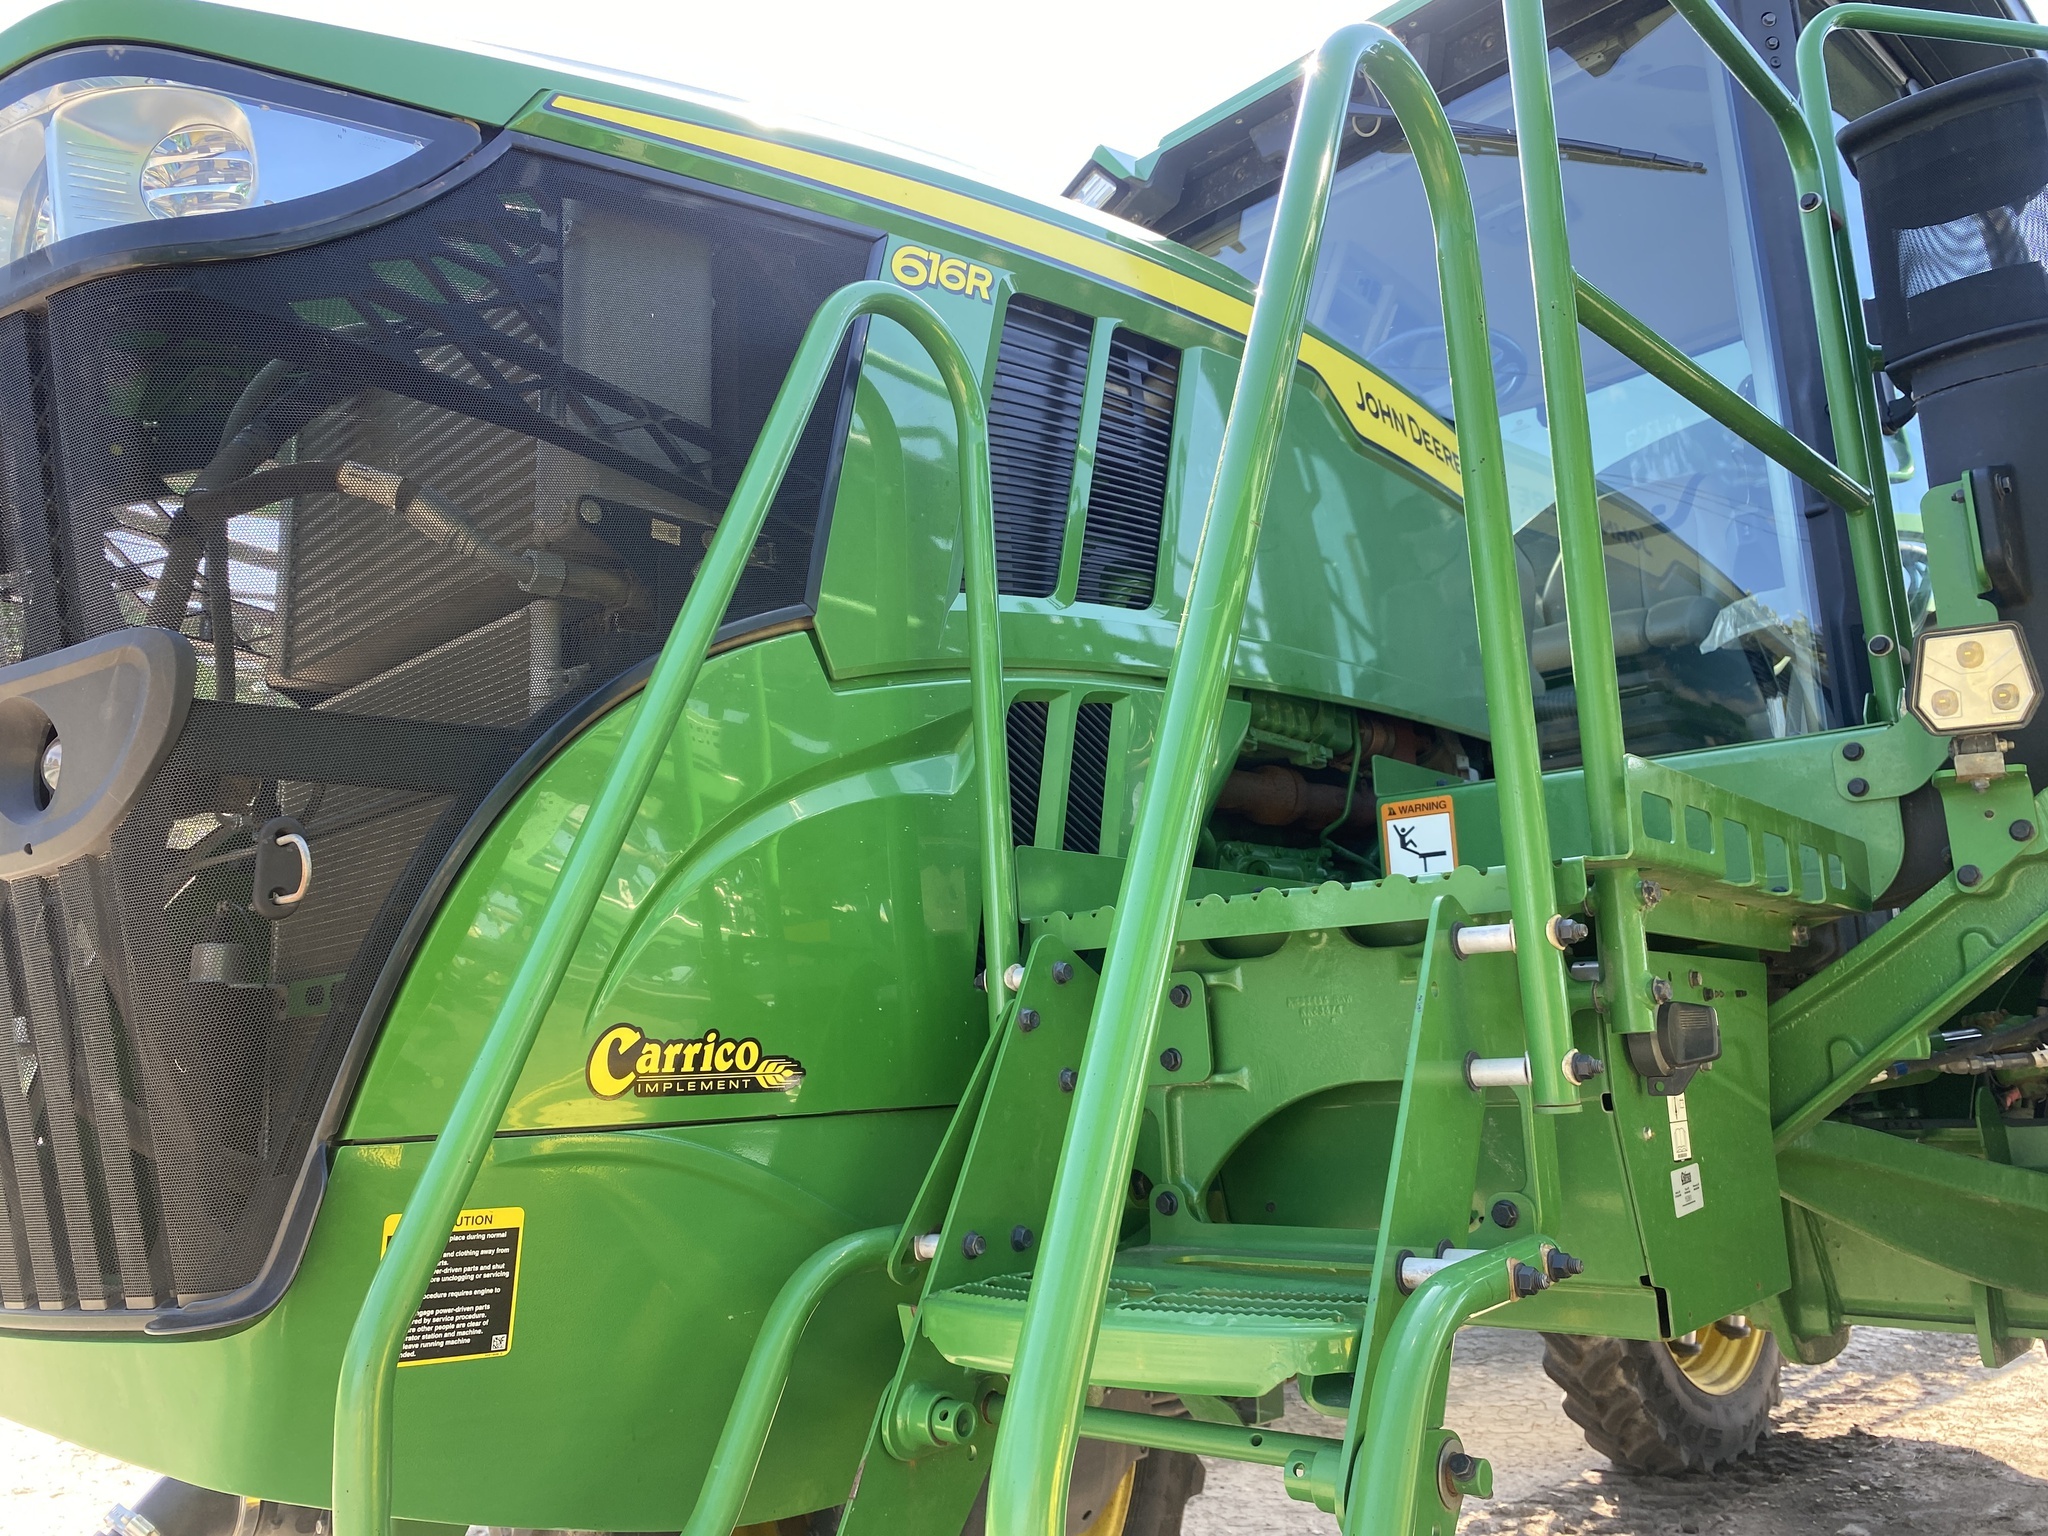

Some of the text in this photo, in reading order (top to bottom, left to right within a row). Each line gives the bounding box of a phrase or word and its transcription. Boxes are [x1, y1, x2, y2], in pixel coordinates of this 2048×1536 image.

[891, 245, 992, 304] 616R
[1355, 381, 1460, 474] JOHN DEERE
[1398, 800, 1447, 814] WARNING
[589, 1025, 760, 1097] Carrico
[638, 1079, 751, 1093] IMPLEMENT
[455, 1215, 493, 1226] UTION
[449, 1234, 465, 1242] place
[467, 1233, 485, 1241] during
[456, 1249, 479, 1257] clothing
[480, 1248, 495, 1256] away
[463, 1265, 478, 1273] parts
[441, 1273, 474, 1282] unclogging
[448, 1290, 473, 1298] requires
[474, 1288, 493, 1296] engine
[435, 1305, 474, 1315] power-driven
[475, 1304, 490, 1312] parts
[424, 1316, 431, 1324] by
[432, 1315, 454, 1323] service
[455, 1312, 487, 1322] procedure.
[434, 1323, 455, 1332] people
[467, 1320, 481, 1328] clear
[422, 1332, 443, 1340] station
[457, 1329, 483, 1337] machine.
[420, 1339, 444, 1348] running
[445, 1337, 470, 1345] machine
